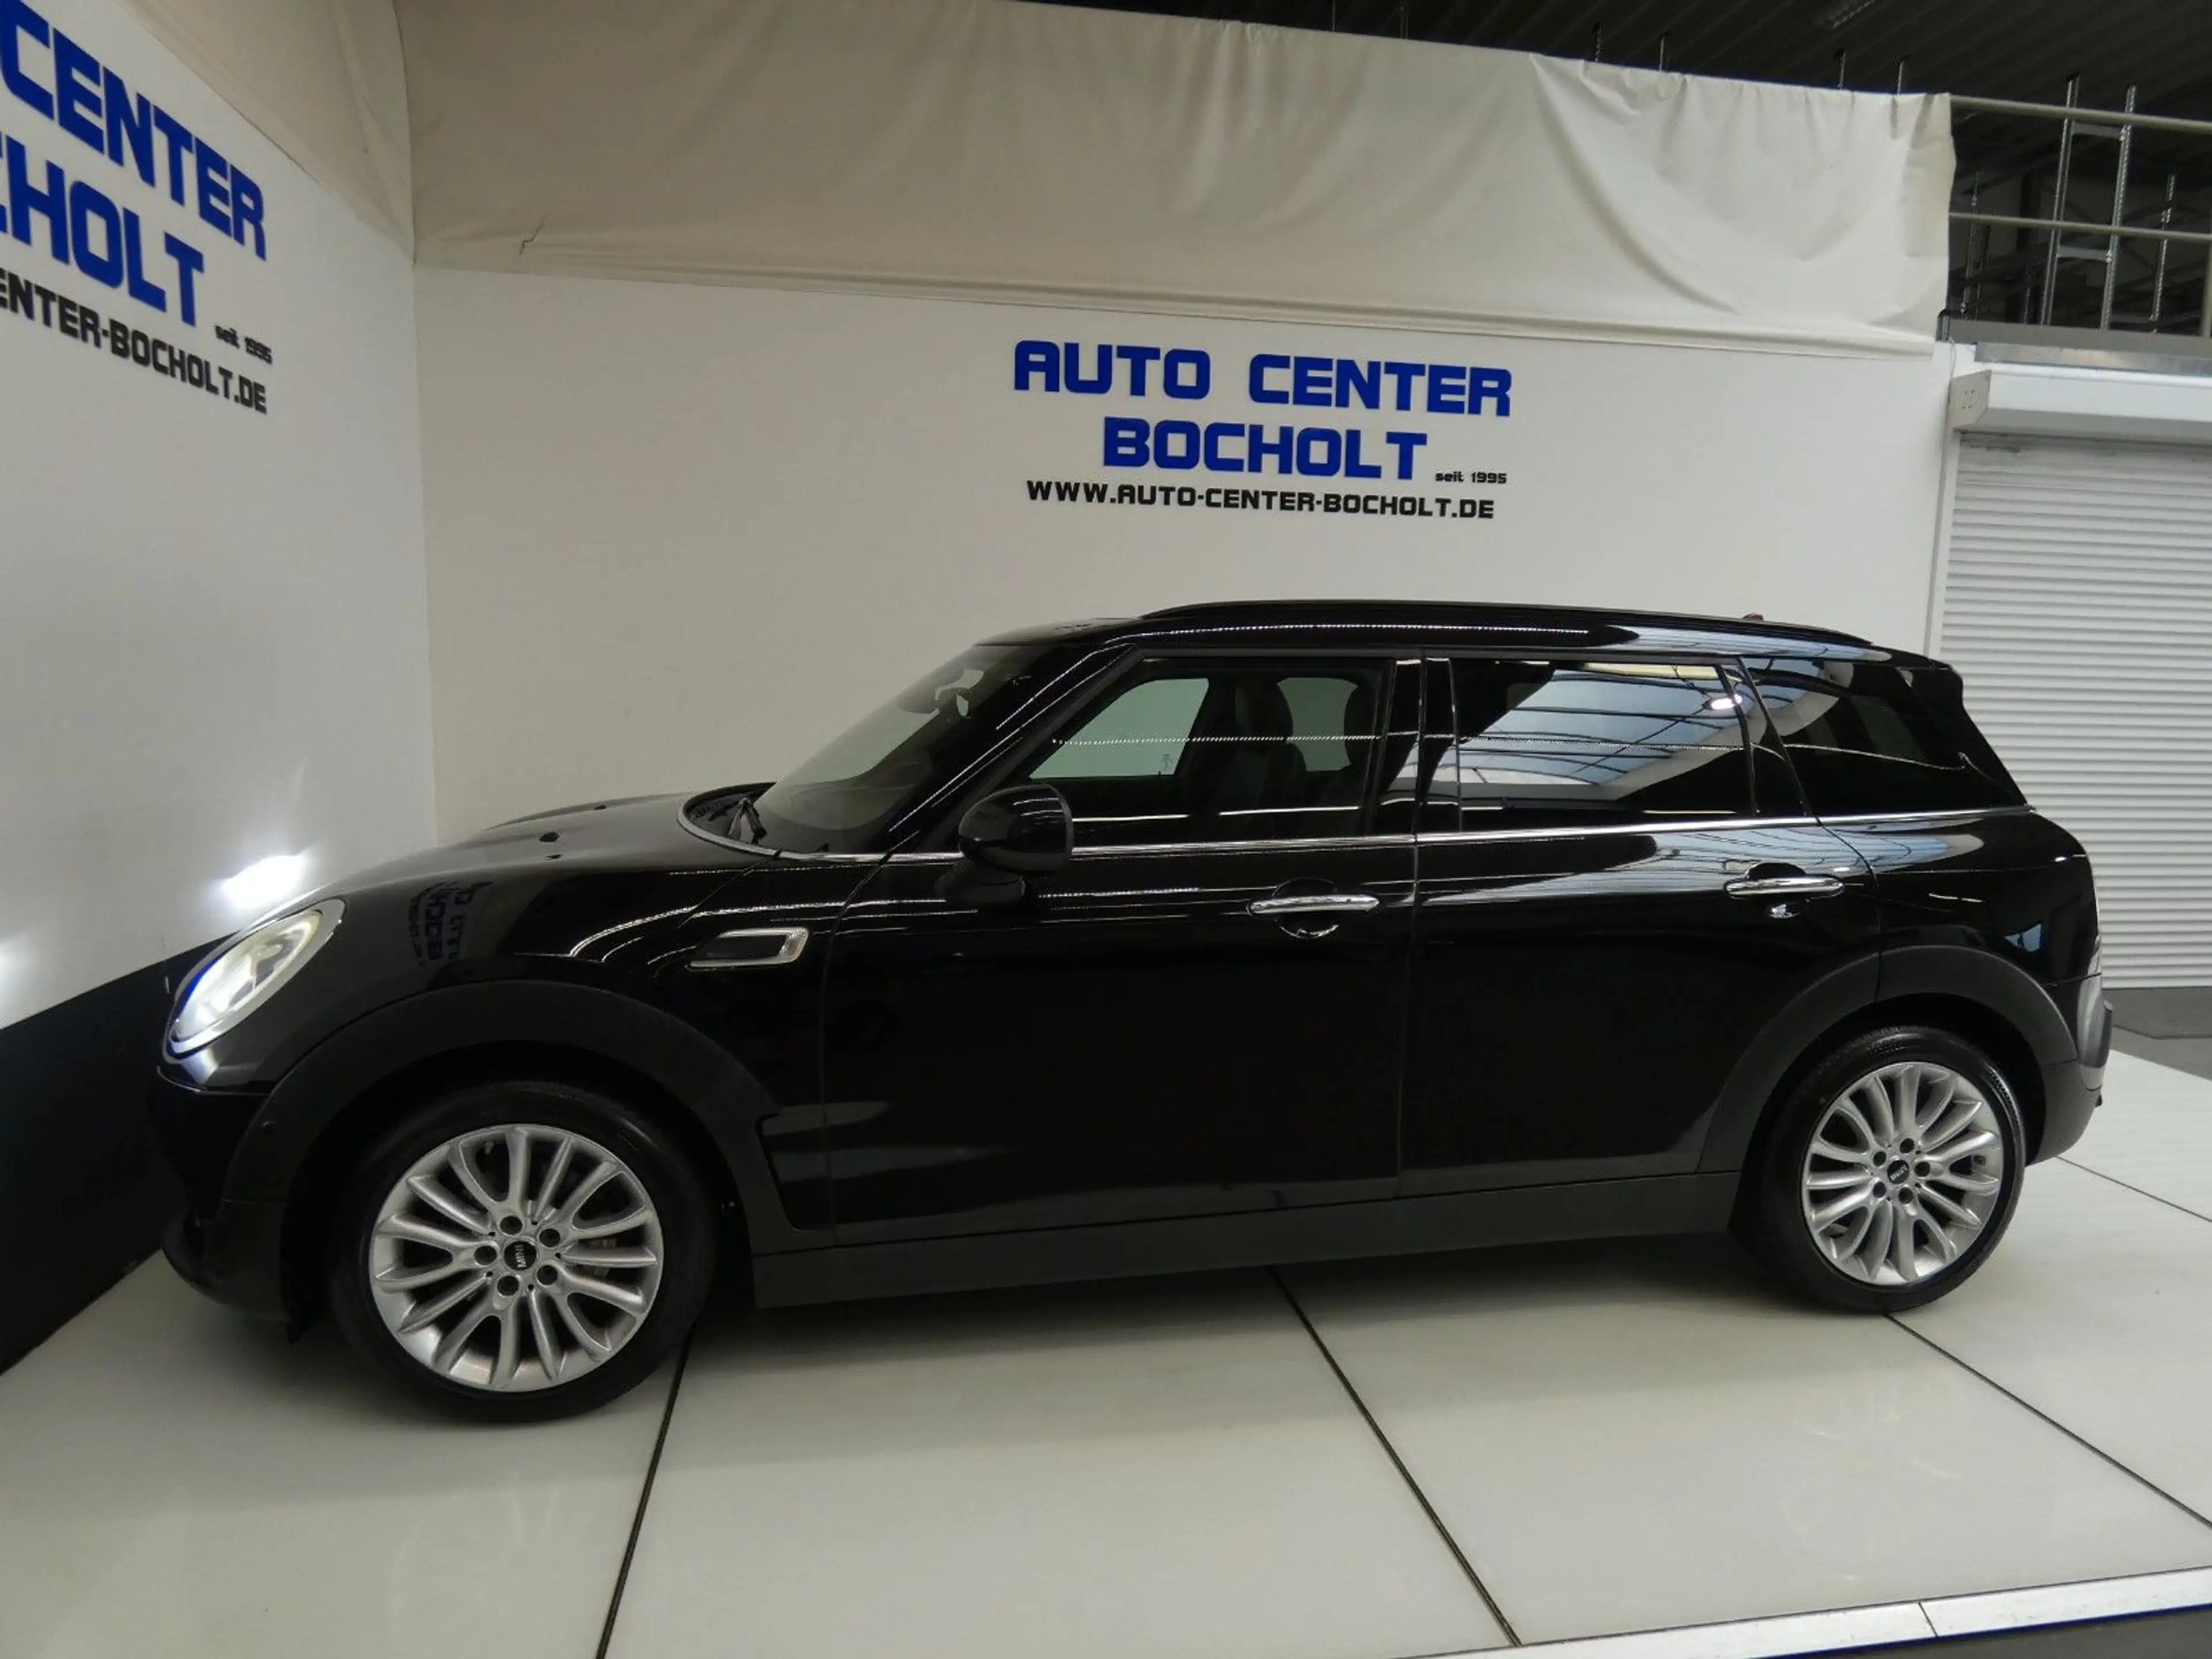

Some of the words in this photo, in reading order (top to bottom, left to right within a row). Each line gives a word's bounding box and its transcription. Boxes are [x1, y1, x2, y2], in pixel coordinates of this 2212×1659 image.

[0, 131, 204, 327] HOLT
[1014, 340, 1211, 400] AUTO
[1249, 353, 1512, 417] CENTER
[1104, 416, 1427, 480] BOCHOLT
[1435, 471, 1464, 483] seit
[1471, 471, 1507, 484] 1995
[1027, 479, 1494, 520] WWW.AUTO-CENTER-BOCHOLT.DE
